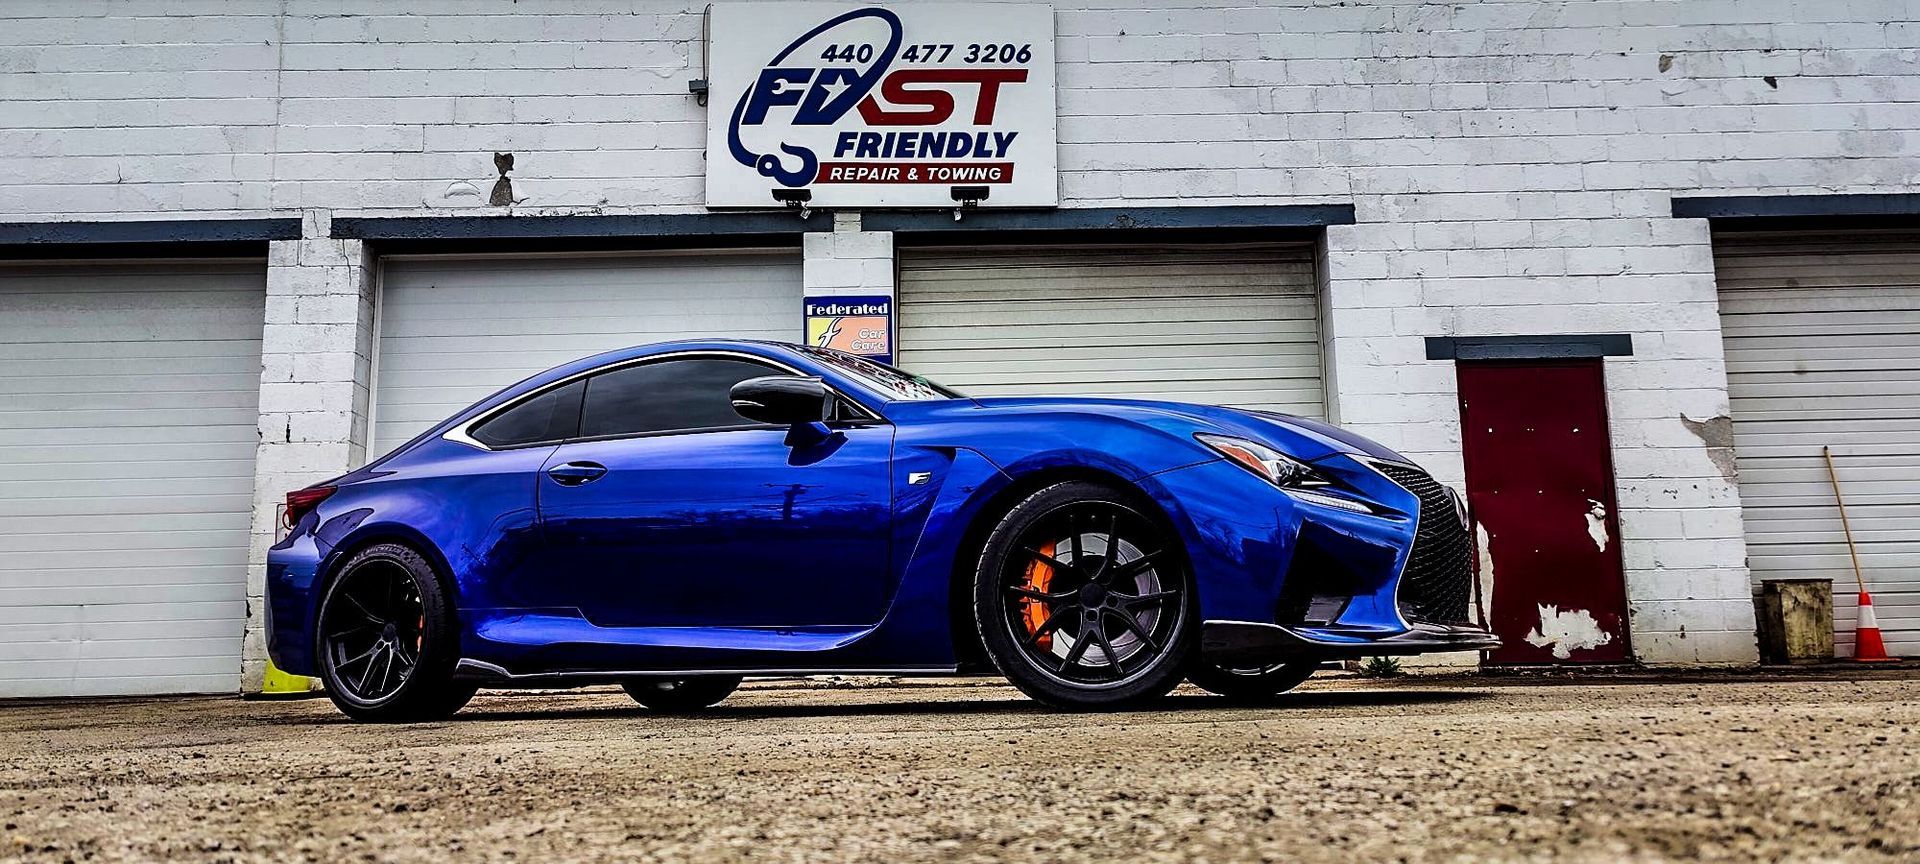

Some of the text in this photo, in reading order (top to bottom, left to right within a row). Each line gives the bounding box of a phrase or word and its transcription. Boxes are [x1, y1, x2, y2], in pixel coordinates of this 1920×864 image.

[821, 44, 1032, 63] 440 477 3206
[833, 131, 1019, 158] FRIENDLY
[830, 167, 1001, 181] REPAIR & TOWING
[807, 303, 888, 315] Federated
[859, 329, 885, 339] Car
[851, 340, 885, 350] Care
